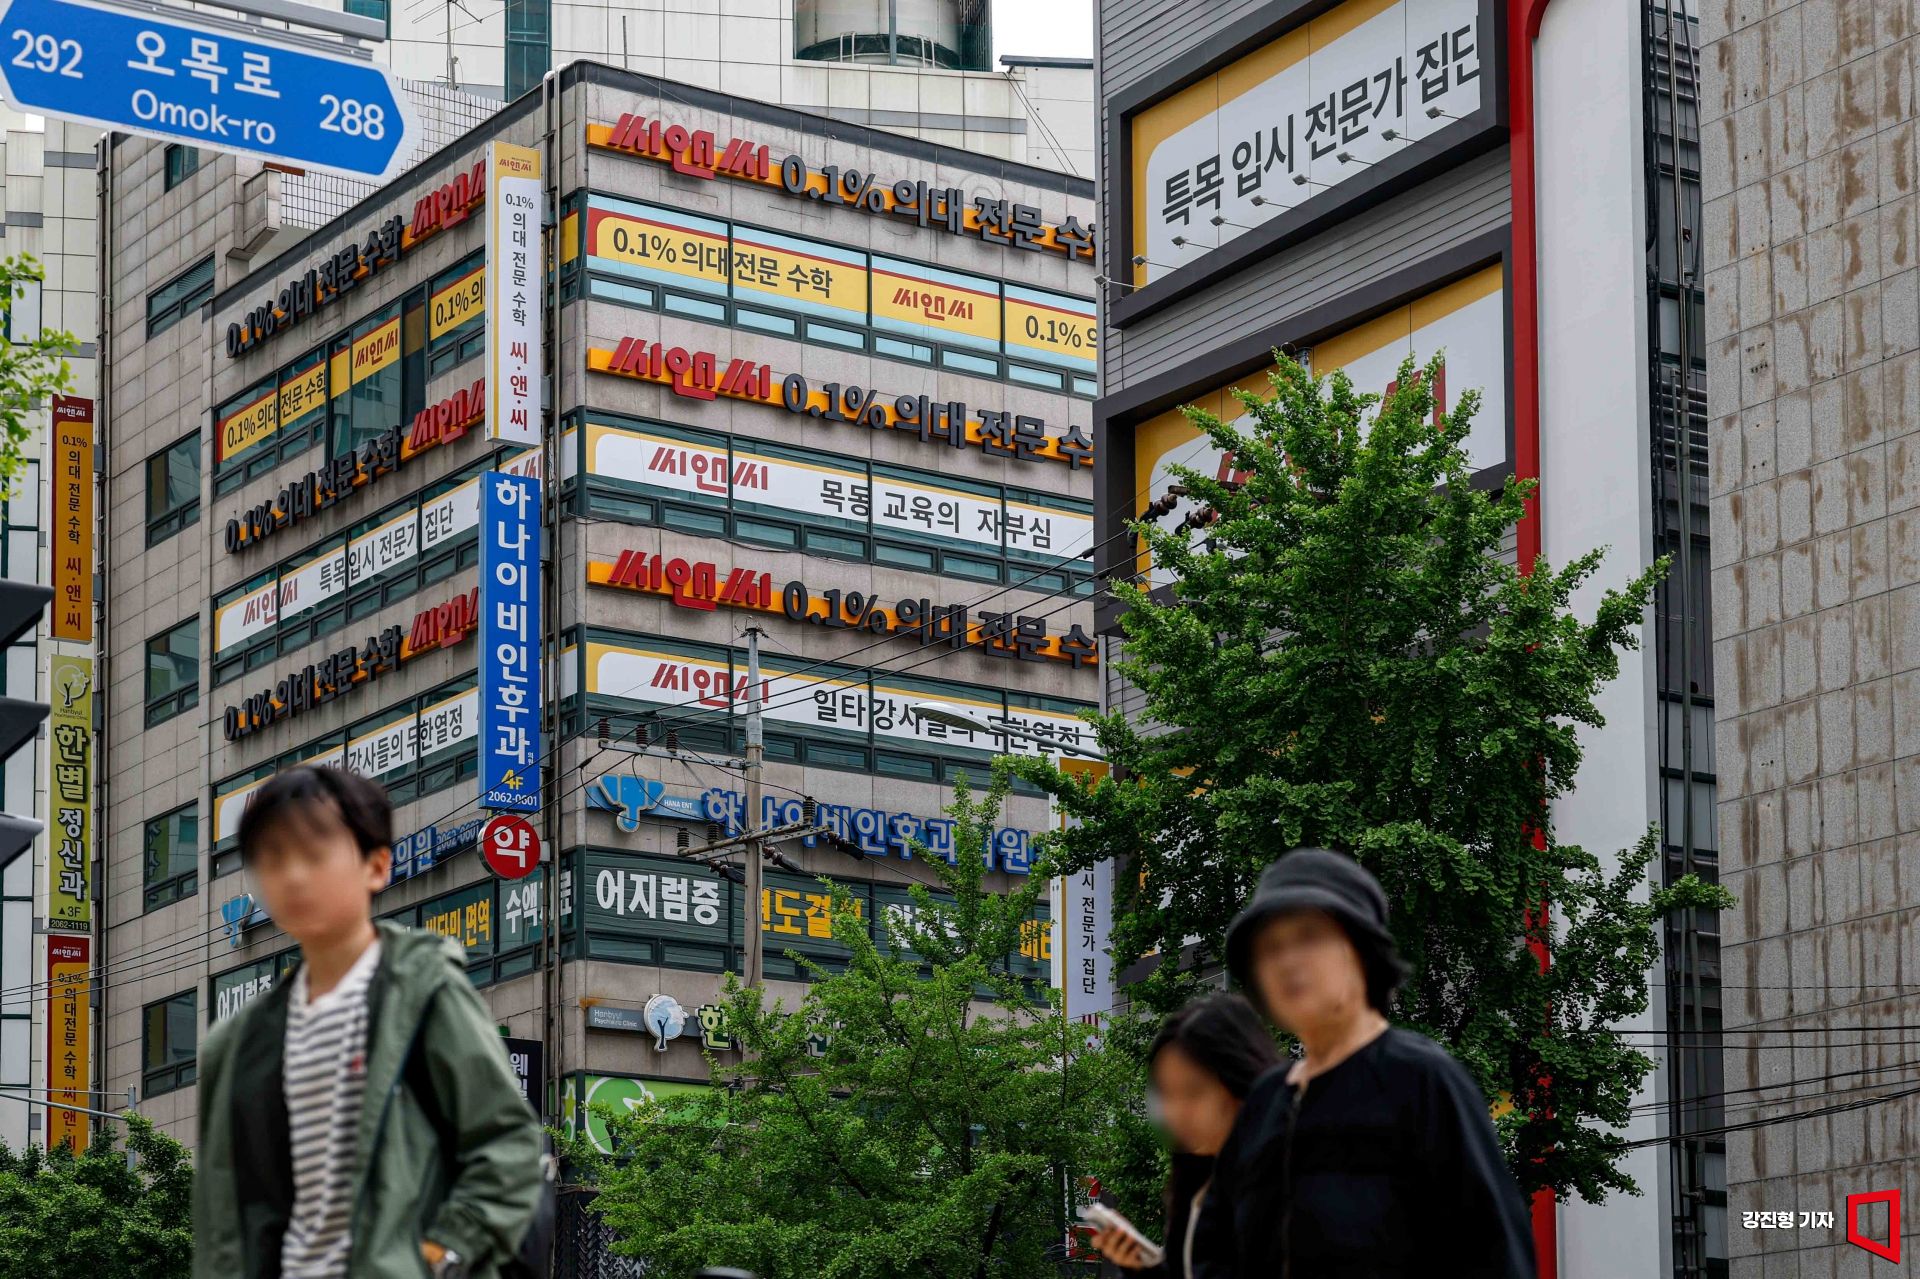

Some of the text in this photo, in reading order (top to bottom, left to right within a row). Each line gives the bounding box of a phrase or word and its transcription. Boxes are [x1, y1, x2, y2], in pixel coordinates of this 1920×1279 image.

[11, 29, 386, 141] 292 오목로 288
[132, 89, 276, 145] Omok-ro
[1162, 154, 1224, 226] 특목
[1232, 114, 1295, 198] 입시
[1304, 56, 1407, 161] 전문가
[780, 154, 886, 215] 0.1%
[893, 179, 963, 235] 의대
[974, 195, 1048, 253] 전문
[1055, 214, 1096, 260] 수
[226, 300, 278, 358] 0.1%
[277, 269, 317, 325] 의대
[318, 243, 360, 304] 전문
[363, 215, 405, 276] 수학
[505, 193, 534, 326] 0.1% 의대 전문 수학
[612, 226, 677, 264] 0.1%
[786, 262, 833, 299] 수학
[435, 289, 469, 328] 0.1%
[1025, 315, 1082, 348] 0.1%
[227, 416, 256, 449] 0.1%
[781, 373, 887, 431] 0.1%
[894, 395, 966, 450] 의대
[976, 409, 1048, 463] 전문
[1057, 425, 1093, 471] 수
[62, 435, 87, 544] 0.1% 의대 전문 수학
[224, 425, 404, 554] 0.1% 의대 전문 수학
[820, 479, 871, 518] 목동
[883, 491, 960, 533] 교육의
[977, 507, 1052, 550] 자부심
[425, 501, 453, 543] 집단
[495, 479, 530, 765] 하나이비인후과
[783, 580, 887, 635] 0.1%
[896, 598, 968, 648] 의대
[978, 611, 1051, 663] 전문
[1059, 624, 1098, 670] 수
[224, 625, 403, 741] 0.1% 의대 전문 수학
[56, 725, 86, 800] 한별
[502, 769, 523, 790] 4F
[488, 791, 537, 806] 2062-0601
[58, 808, 86, 900] 정신과
[493, 825, 530, 868] 약
[51, 920, 88, 931] 2062-1119
[67, 907, 81, 918] 3F
[466, 898, 489, 947] 면역
[596, 870, 720, 925] 어지럼증
[1082, 897, 1095, 952] 전문가
[1082, 959, 1096, 995] 집단
[64, 1050, 76, 1080] 수학
